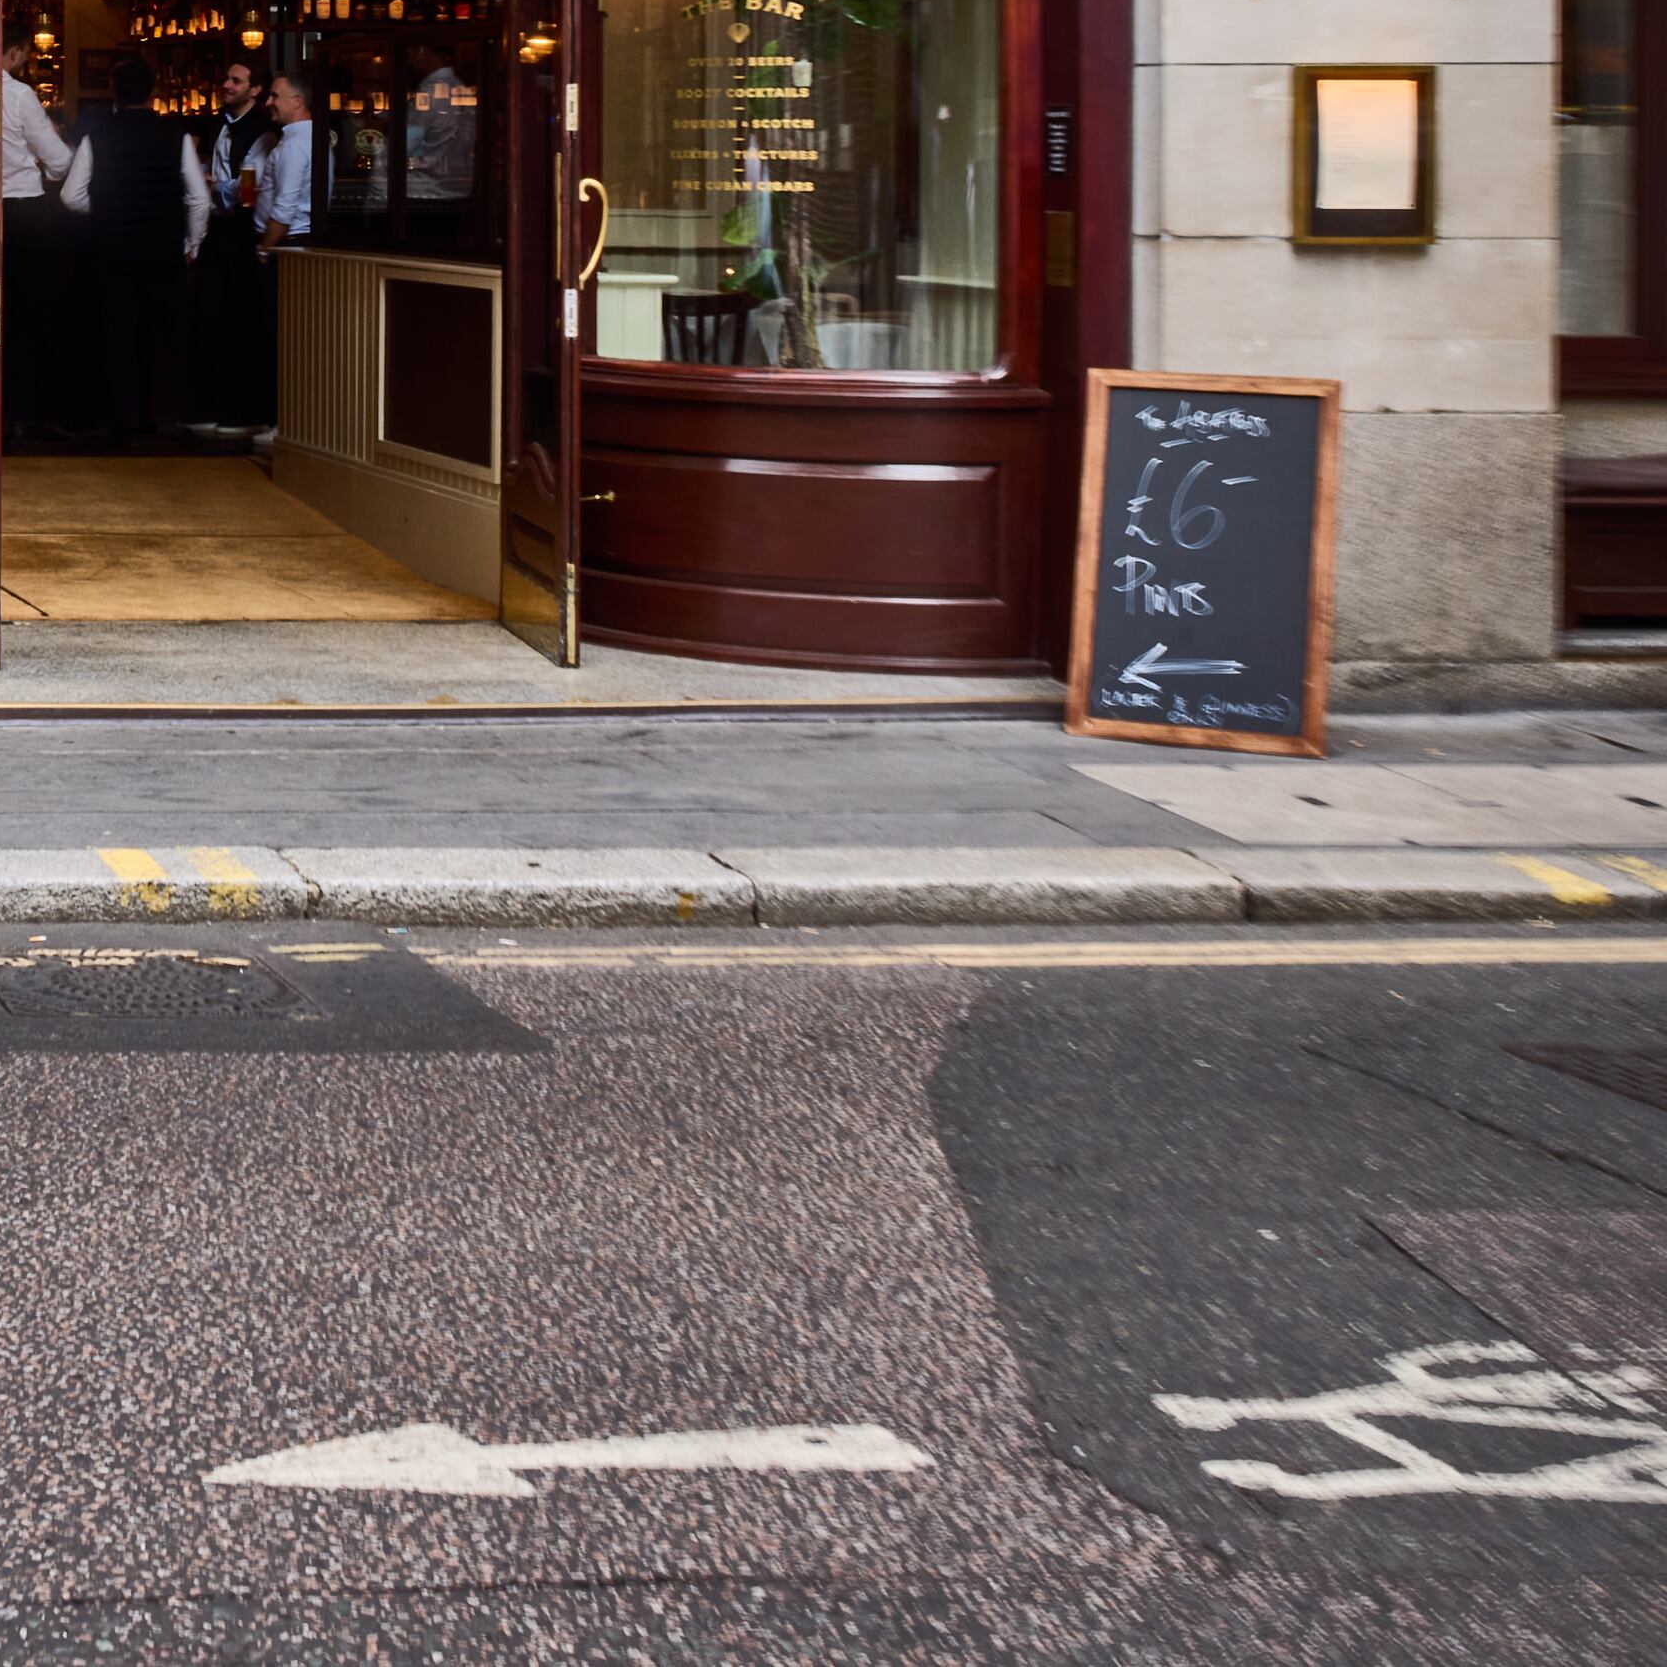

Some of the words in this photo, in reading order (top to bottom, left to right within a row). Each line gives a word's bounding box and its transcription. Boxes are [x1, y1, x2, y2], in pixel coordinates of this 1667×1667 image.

[747, 56, 797, 68] BEERS
[725, 87, 811, 99] COCKTAILS
[672, 119, 737, 130] BOURBON
[751, 118, 816, 130] SCOTCH
[704, 179, 753, 192] CUBAN
[756, 180, 816, 193] CIGARS
